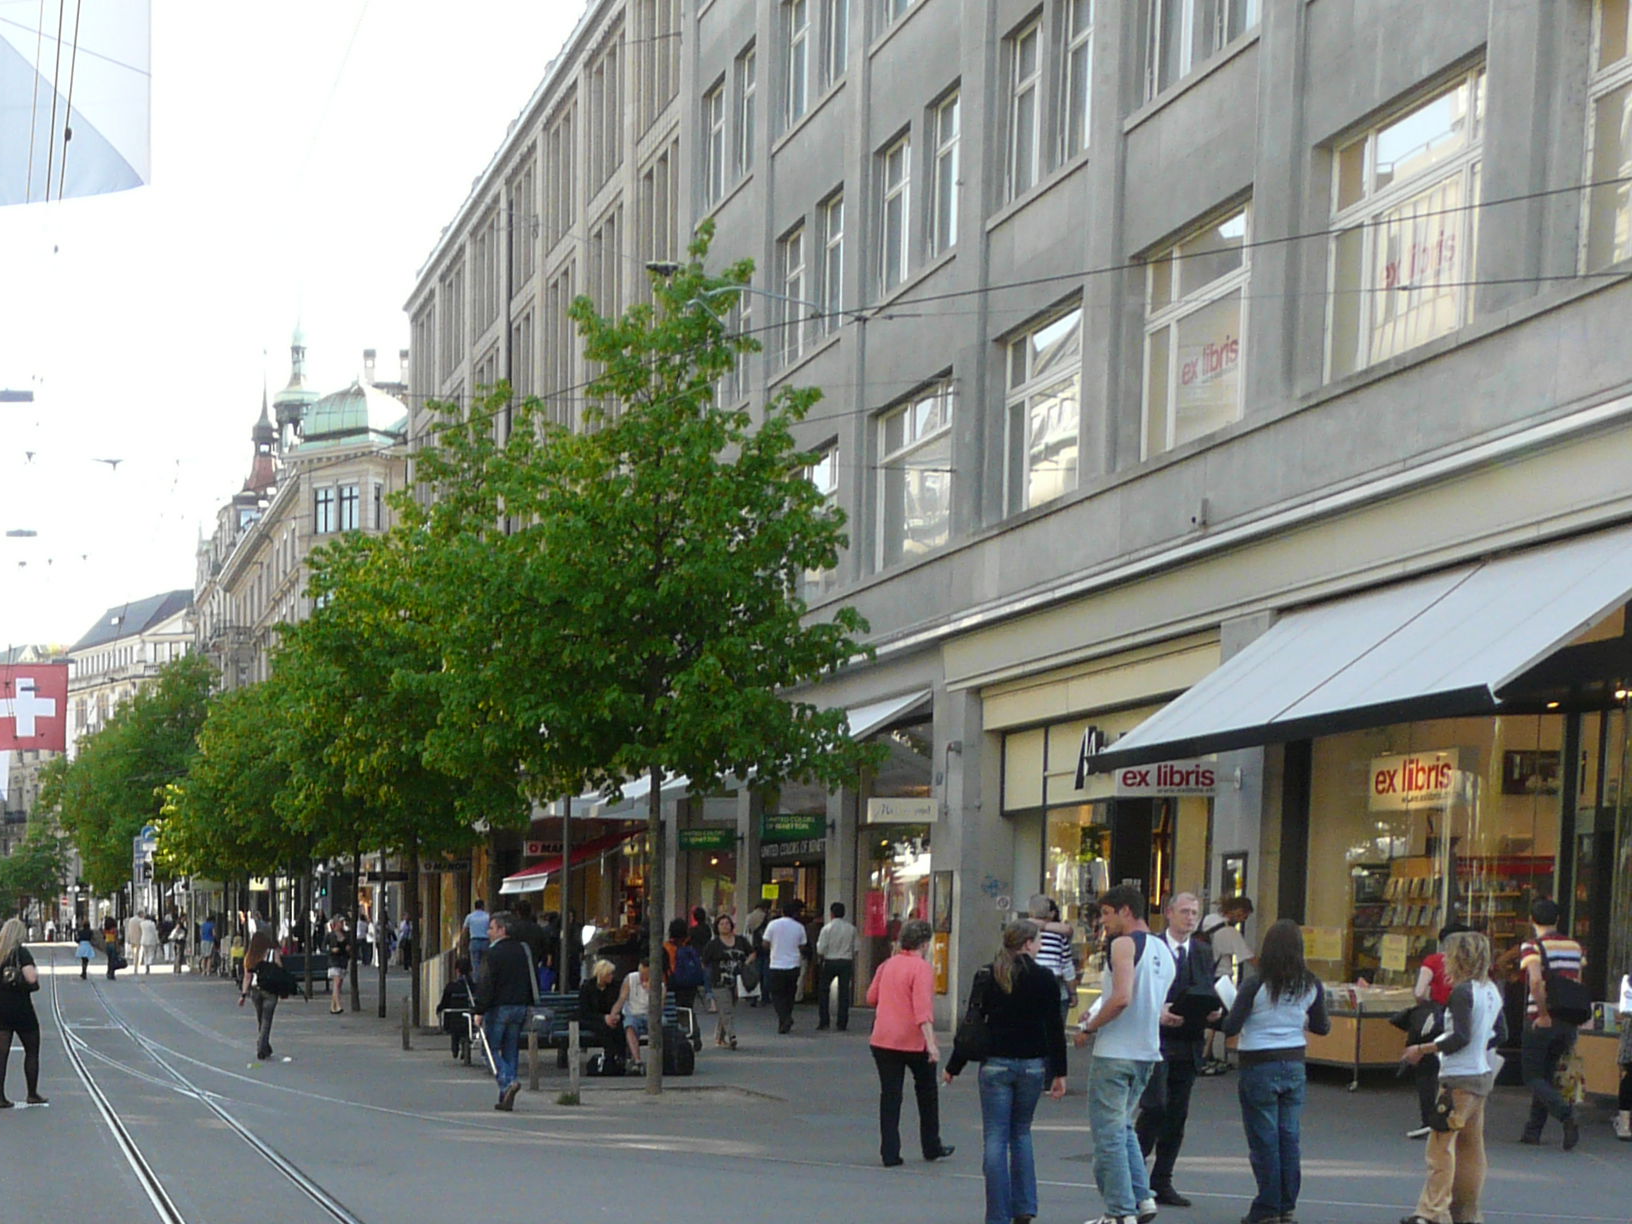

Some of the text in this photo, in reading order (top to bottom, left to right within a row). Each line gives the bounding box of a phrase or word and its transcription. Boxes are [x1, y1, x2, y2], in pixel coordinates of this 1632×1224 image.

[1181, 358, 1199, 385] ex
[1202, 334, 1239, 377] libris
[1121, 763, 1216, 788] ex libris
[1374, 754, 1453, 795] ex libris
